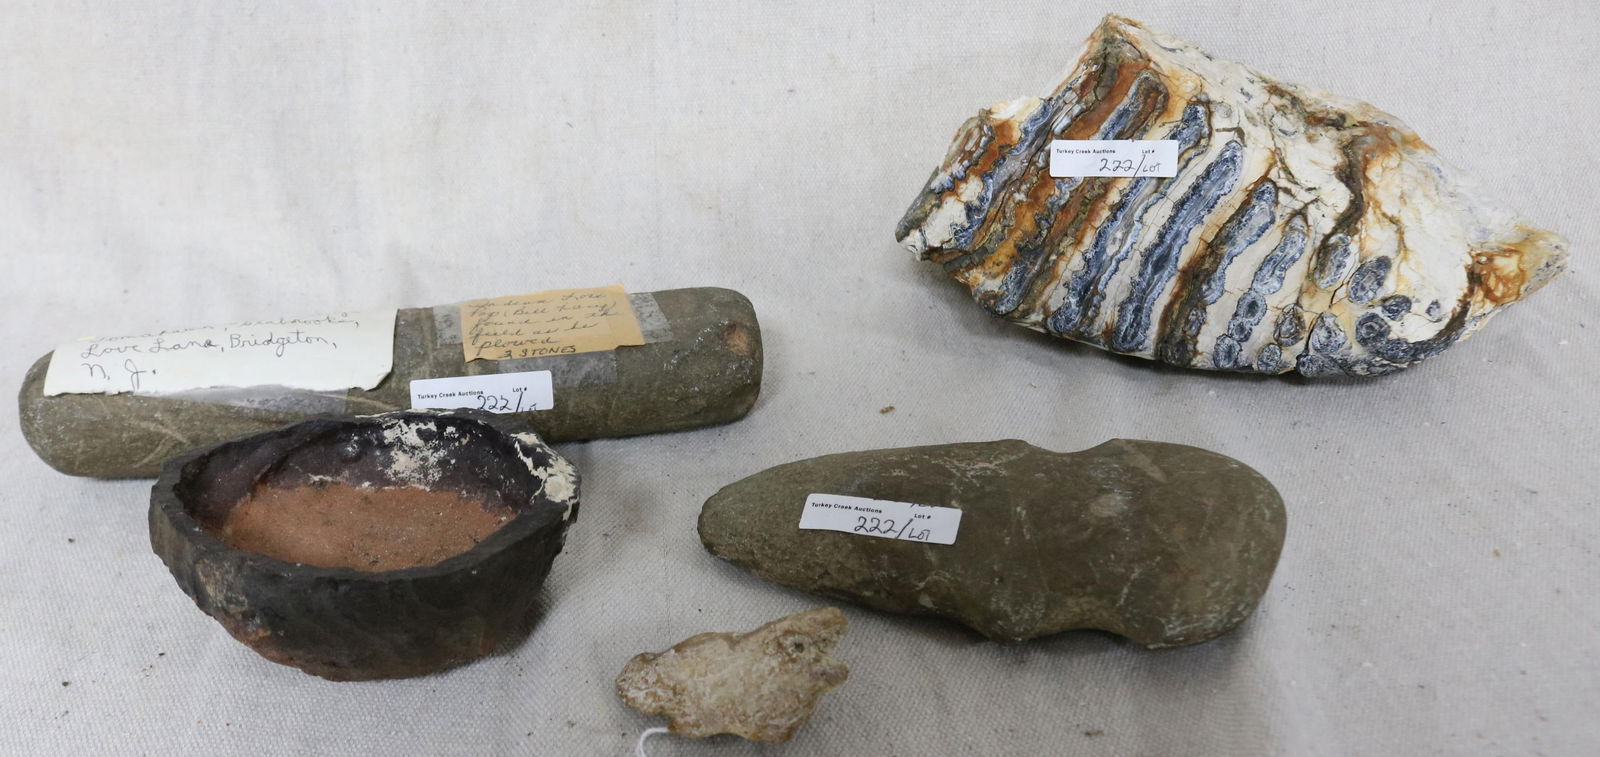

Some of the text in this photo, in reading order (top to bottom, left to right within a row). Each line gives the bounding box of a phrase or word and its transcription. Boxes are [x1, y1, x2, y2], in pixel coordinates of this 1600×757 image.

[81, 344, 142, 359] Love
[229, 329, 337, 358] Bridgeton,
[853, 506, 883, 514] Auctions
